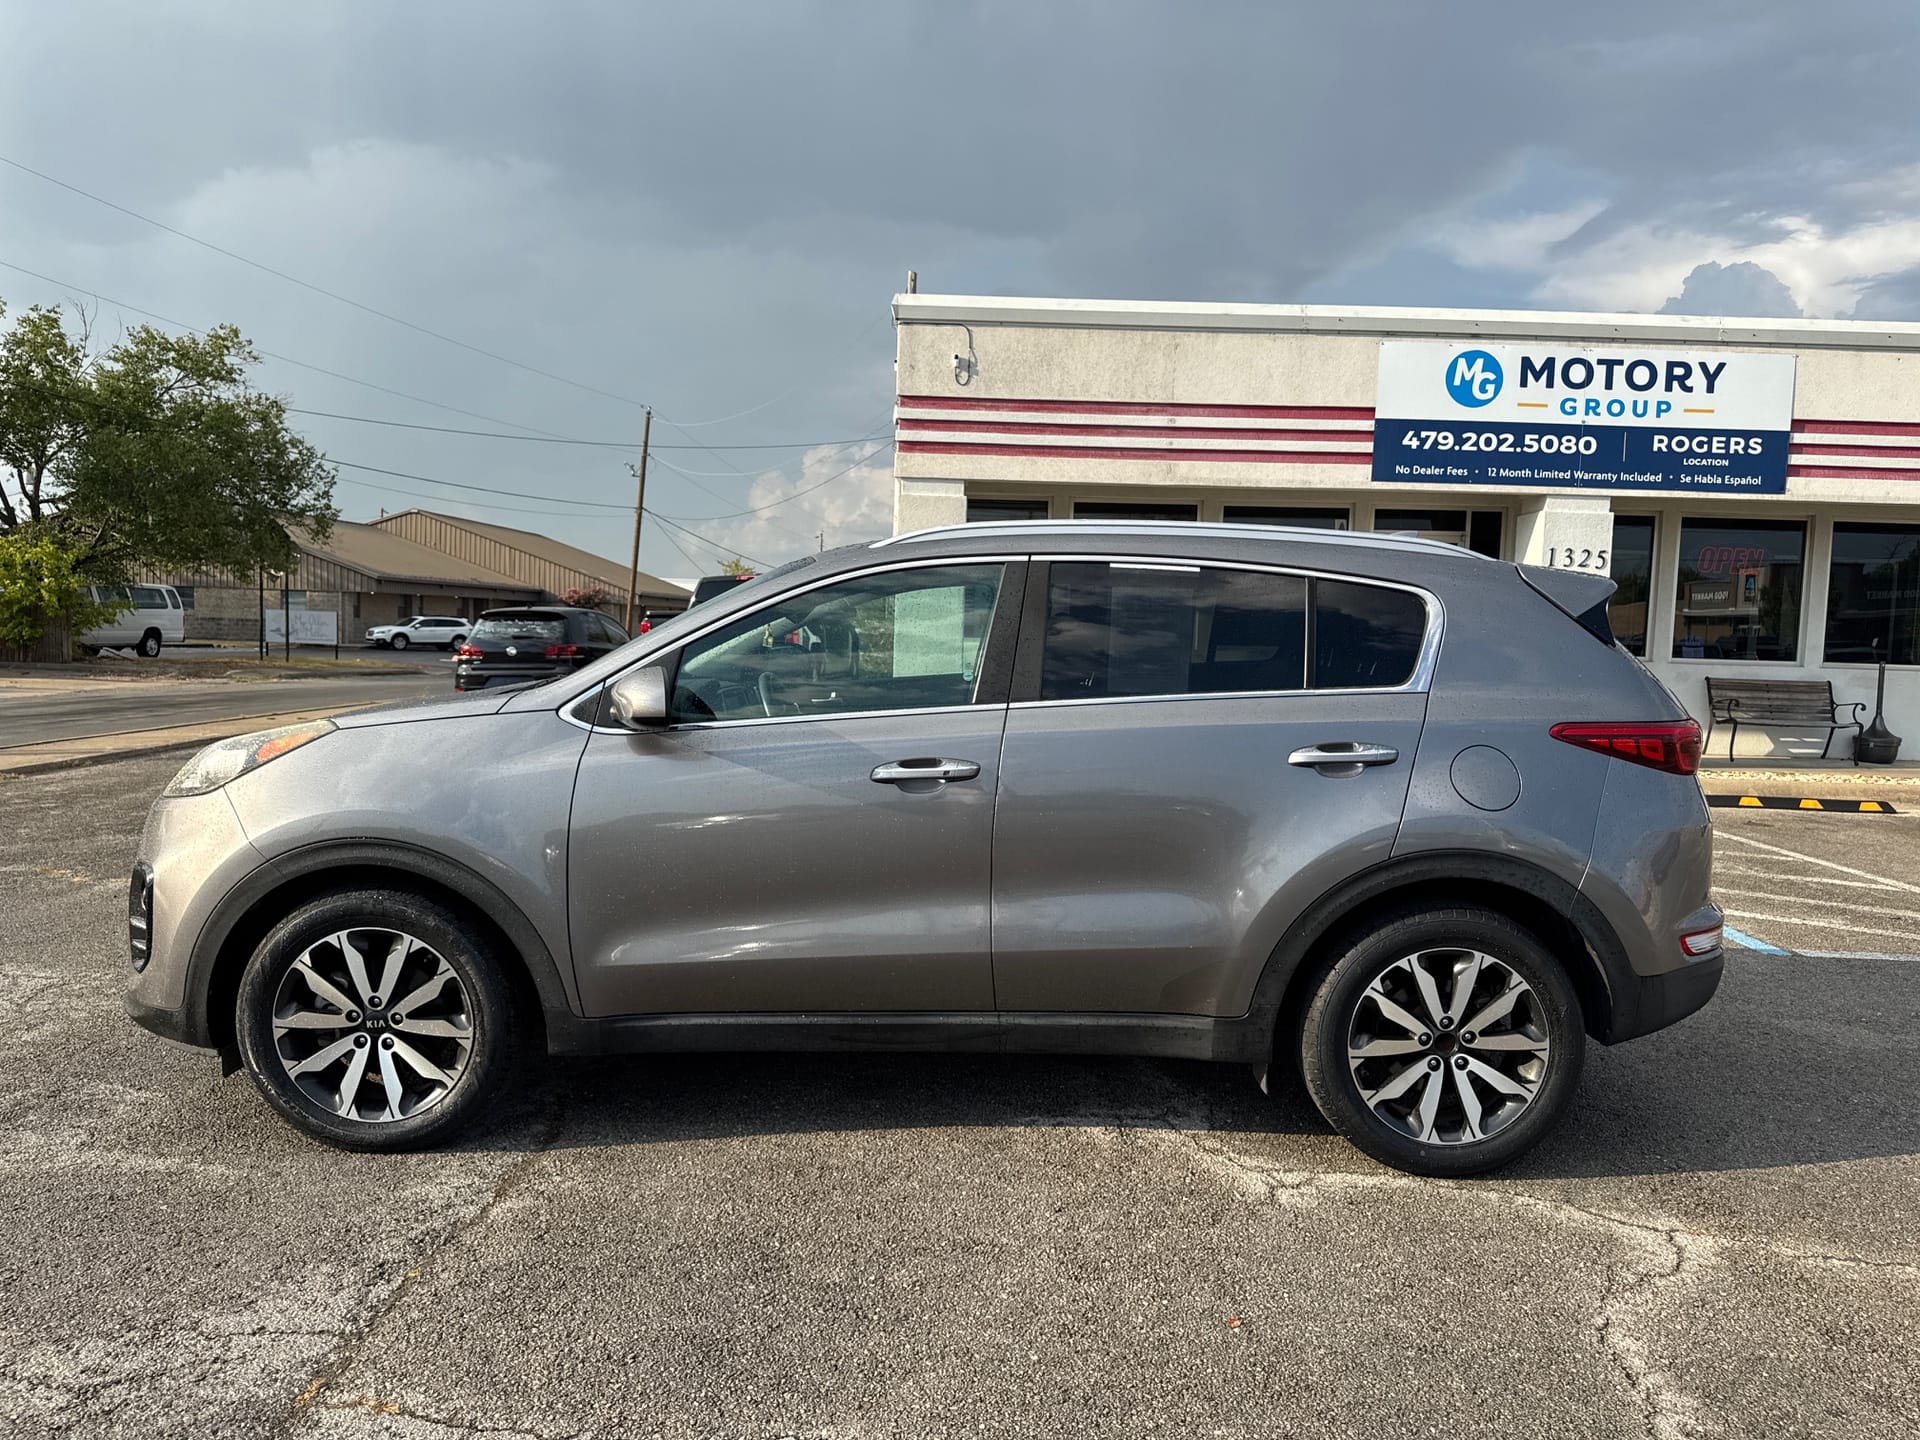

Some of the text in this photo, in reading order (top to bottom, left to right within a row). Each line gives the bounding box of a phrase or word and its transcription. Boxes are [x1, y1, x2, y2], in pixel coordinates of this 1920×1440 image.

[1453, 357, 1497, 401] MG
[1519, 356, 1727, 394] MOTORY
[1559, 397, 1672, 419] GROUP
[1401, 430, 1598, 456] 479.202.5080
[1652, 434, 1763, 456] ROGERS
[1683, 458, 1730, 467] LOCATION
[1395, 465, 1763, 488] No Dealer Fees 12 Month Limited Warranty Included Se Habla Español
[1548, 547, 1609, 570] 1325
[1697, 546, 1765, 575] OPEN
[366, 1020, 386, 1029] KIA
